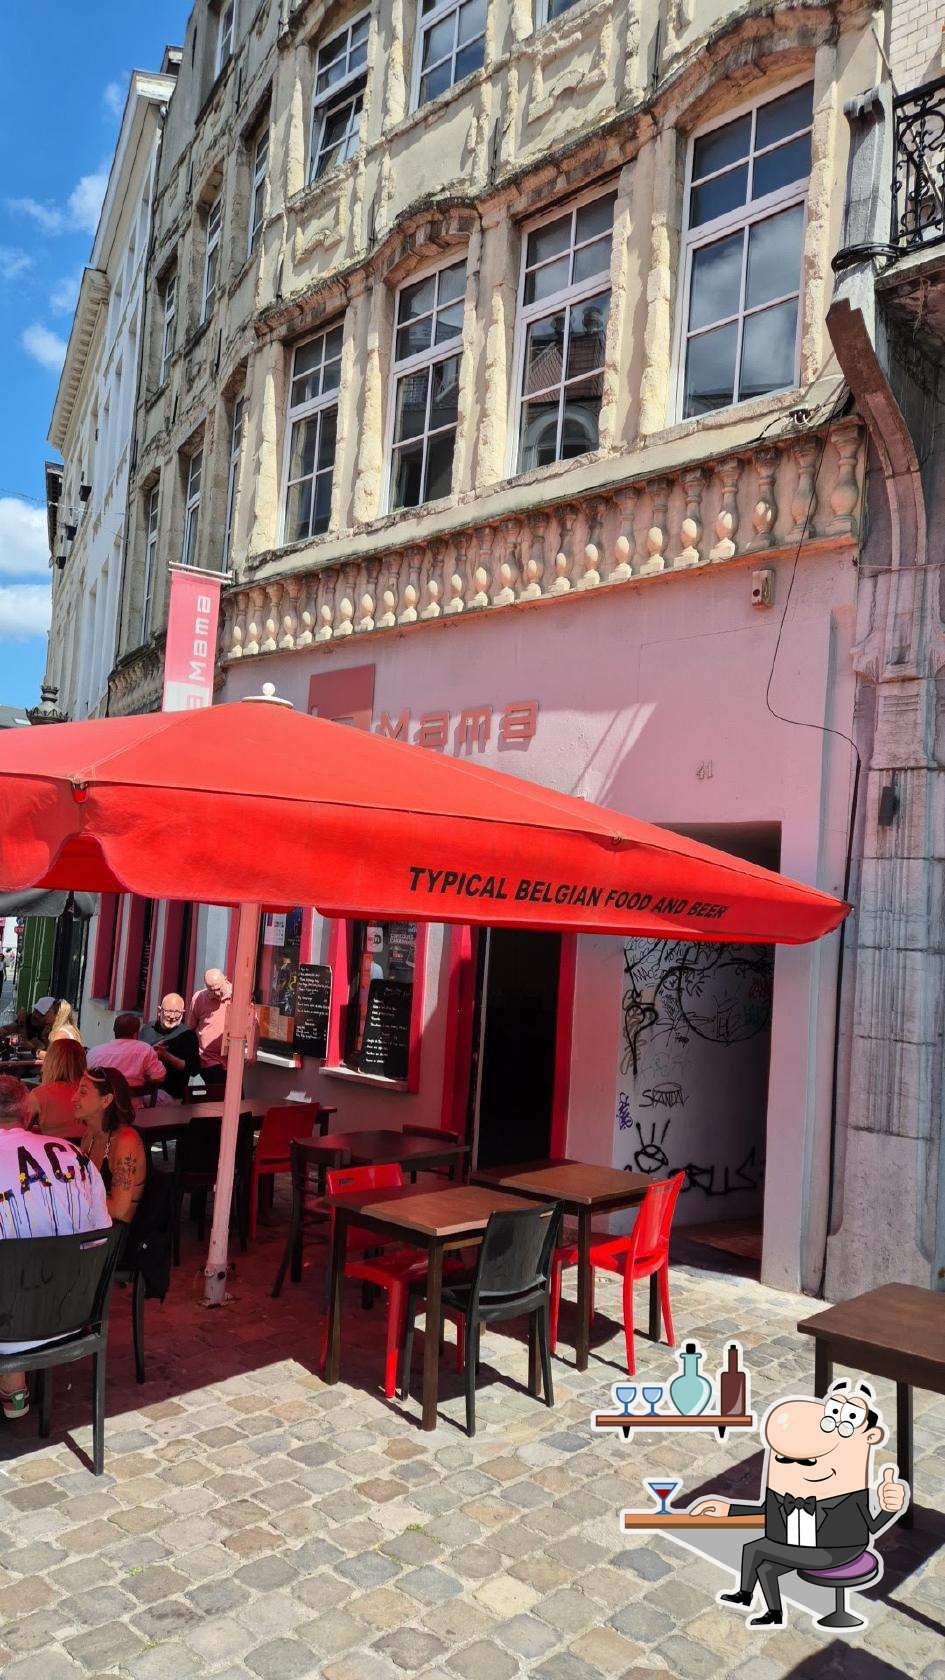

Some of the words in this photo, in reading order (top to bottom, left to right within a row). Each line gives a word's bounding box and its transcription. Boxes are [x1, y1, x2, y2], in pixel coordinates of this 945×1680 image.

[696, 760, 713, 780] 41
[409, 866, 508, 900] TYPICAL
[515, 879, 604, 907] BELGIAN
[604, 889, 652, 911] FOOD
[651, 896, 688, 915] AND
[687, 901, 728, 919] BEER
